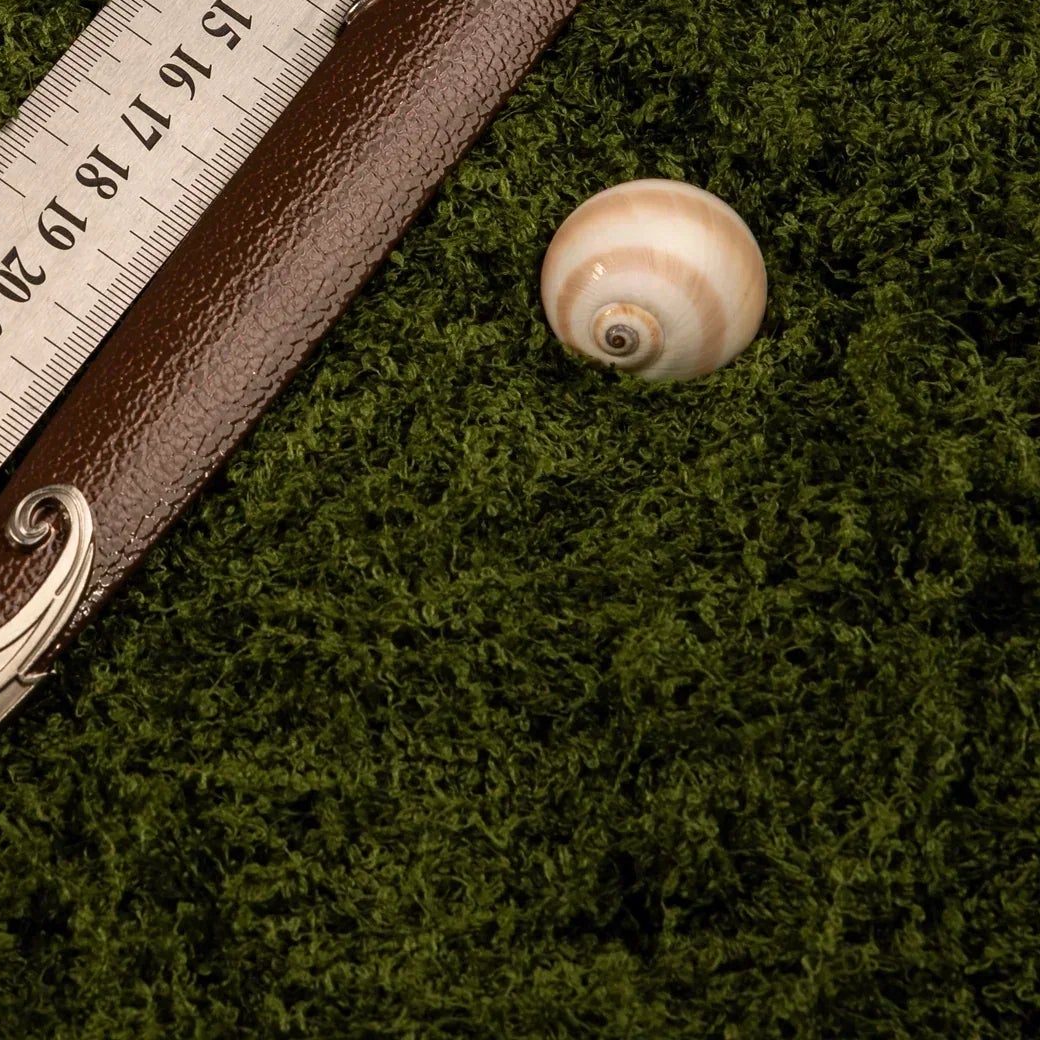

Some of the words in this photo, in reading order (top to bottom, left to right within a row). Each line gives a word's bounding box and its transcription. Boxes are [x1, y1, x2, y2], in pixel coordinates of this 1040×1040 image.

[159, 44, 212, 100] 16
[121, 93, 171, 151] 17
[75, 144, 130, 199] 18
[37, 196, 87, 251] 19
